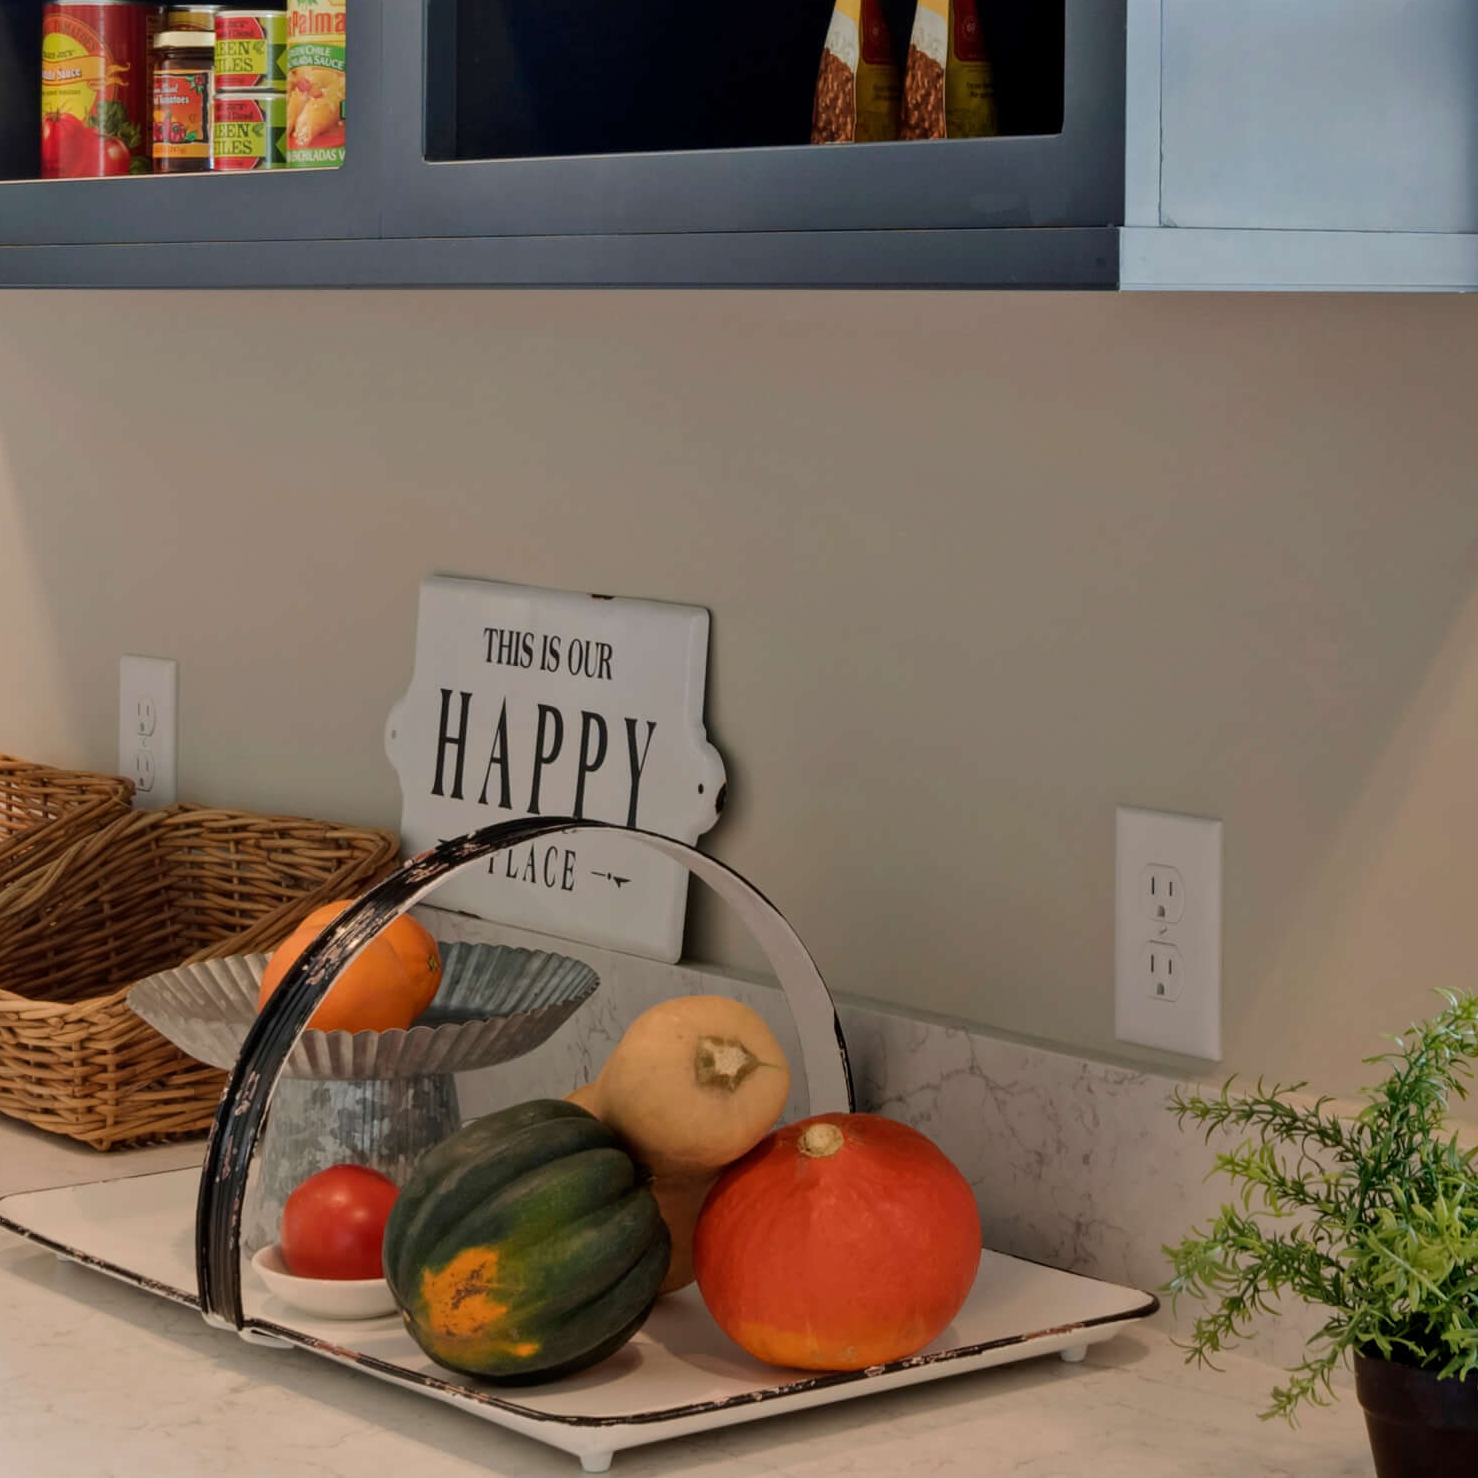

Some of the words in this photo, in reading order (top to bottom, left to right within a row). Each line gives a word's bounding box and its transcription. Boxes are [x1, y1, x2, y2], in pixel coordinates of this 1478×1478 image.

[216, 41, 250, 55] EEN
[306, 45, 331, 57] CHILE
[313, 55, 346, 70] SAUCE
[215, 123, 250, 138] EEN
[483, 627, 535, 669] THIS
[540, 634, 562, 673] IS
[568, 638, 614, 680] OUR
[431, 687, 657, 828] HAPPY
